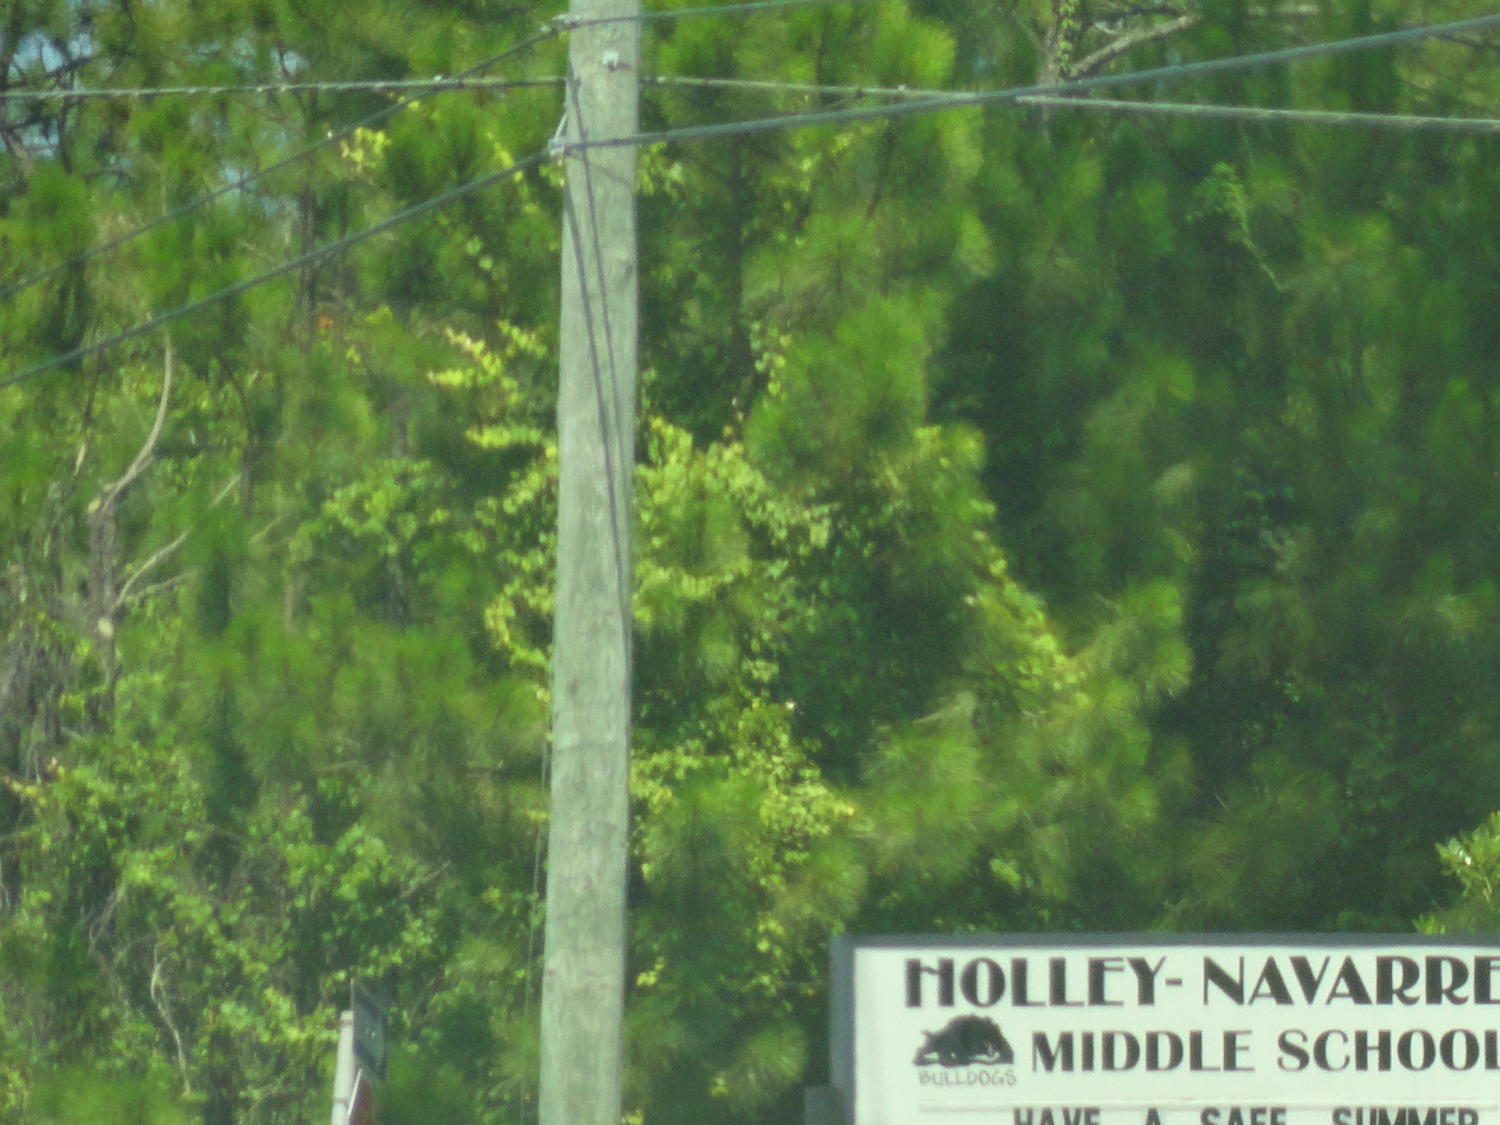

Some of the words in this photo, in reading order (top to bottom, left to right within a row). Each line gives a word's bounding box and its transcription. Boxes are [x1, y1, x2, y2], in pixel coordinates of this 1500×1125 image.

[906, 956, 1182, 1007] HOLLEY-
[1031, 1029, 1254, 1072] MIDDLE
[918, 1069, 1017, 1087] BULLDOGS
